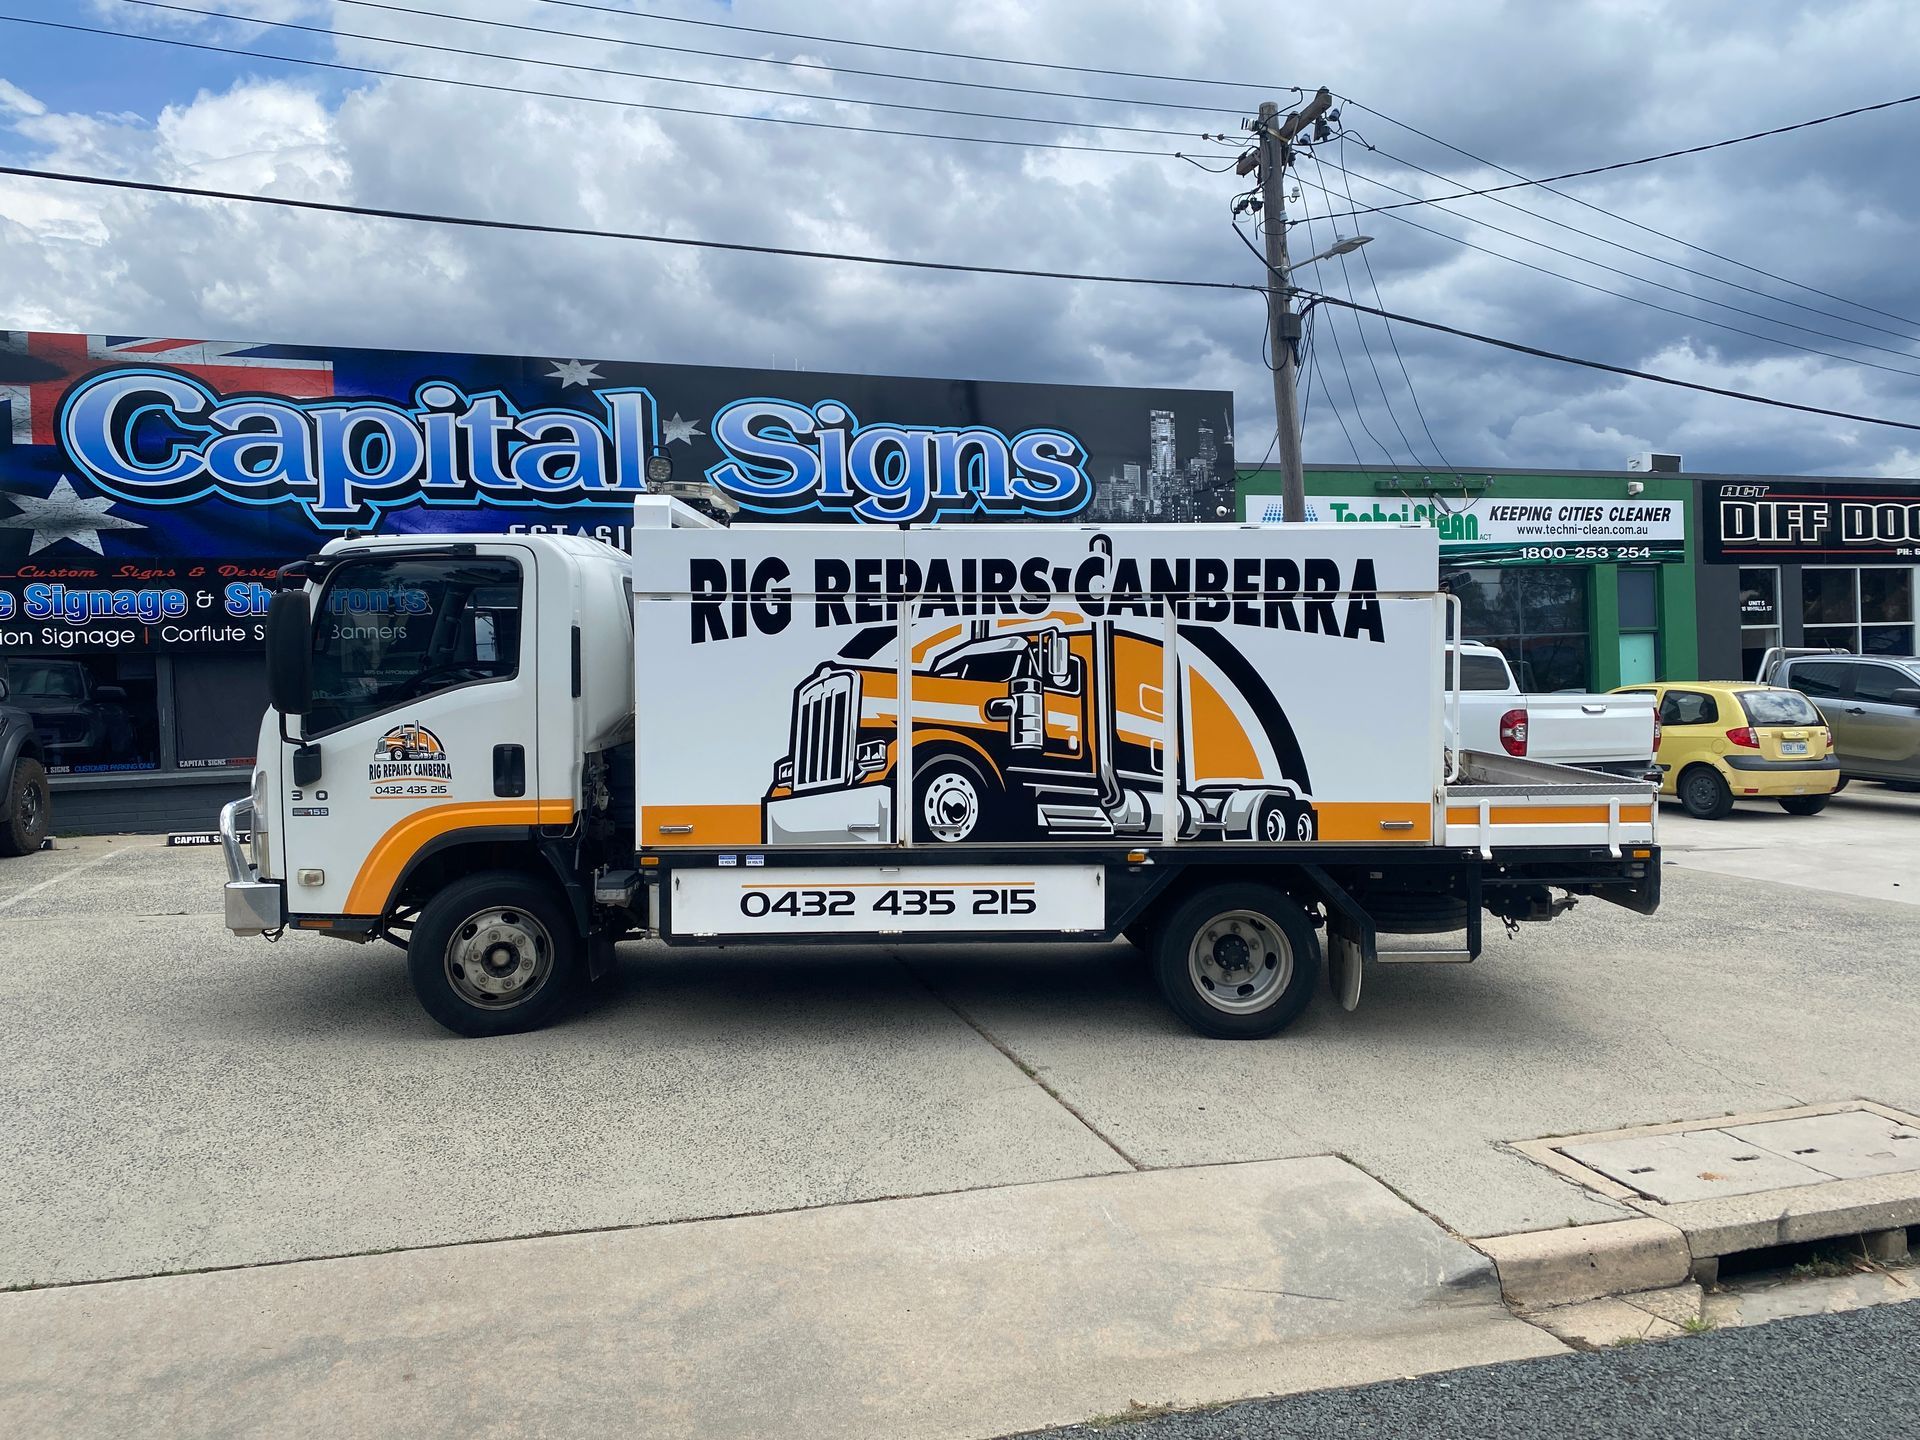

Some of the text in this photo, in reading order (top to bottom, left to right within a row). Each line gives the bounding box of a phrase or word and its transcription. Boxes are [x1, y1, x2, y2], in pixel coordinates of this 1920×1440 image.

[67, 374, 1080, 521] Capital Signs
[1719, 485, 1770, 498] ACT
[1488, 505, 1672, 522] KEEPING CITIES CLEANER
[1719, 501, 1829, 542] DIFF
[1516, 524, 1649, 536] www.techni-clean.com.au
[1518, 546, 1651, 559] 1800 253 254
[16, 565, 99, 578] Custom
[112, 565, 177, 580] Signs
[188, 566, 206, 577] &
[24, 582, 188, 626] Signage
[196, 590, 215, 608] &
[690, 556, 1386, 644] RIG REPAIRS CANBERRA
[41, 627, 136, 648] Signage
[161, 625, 246, 643] Corflute
[179, 759, 206, 767] CAPITAL
[369, 763, 453, 780] RIG REPAIRS CANBERRA
[375, 785, 447, 794] 0432 435 215
[174, 835, 211, 845] CAPITAL
[740, 889, 1037, 918] 0432 435 215
